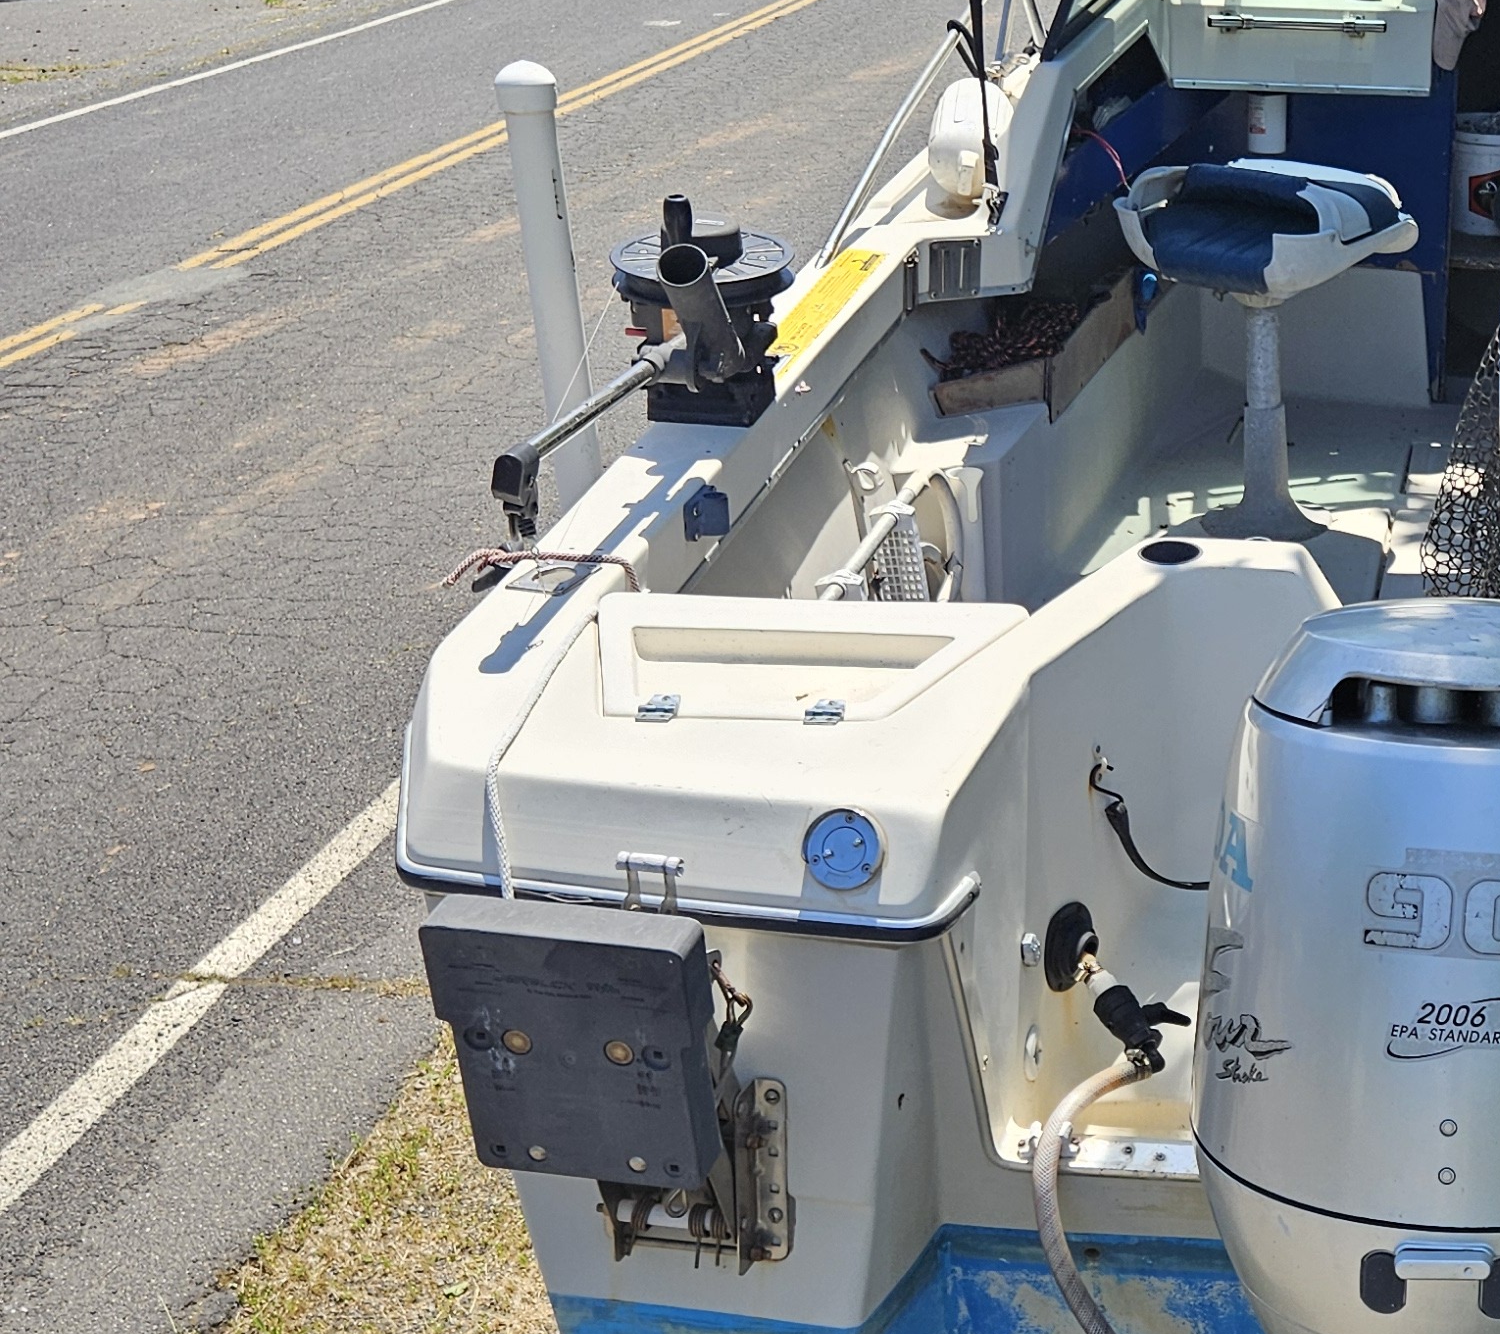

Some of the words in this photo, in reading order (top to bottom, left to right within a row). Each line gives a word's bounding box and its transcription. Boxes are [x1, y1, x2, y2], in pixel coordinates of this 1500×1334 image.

[1417, 1002, 1487, 1027] 2006
[1390, 1024, 1419, 1040] EPA
[1215, 1056, 1269, 1084] Stroke
